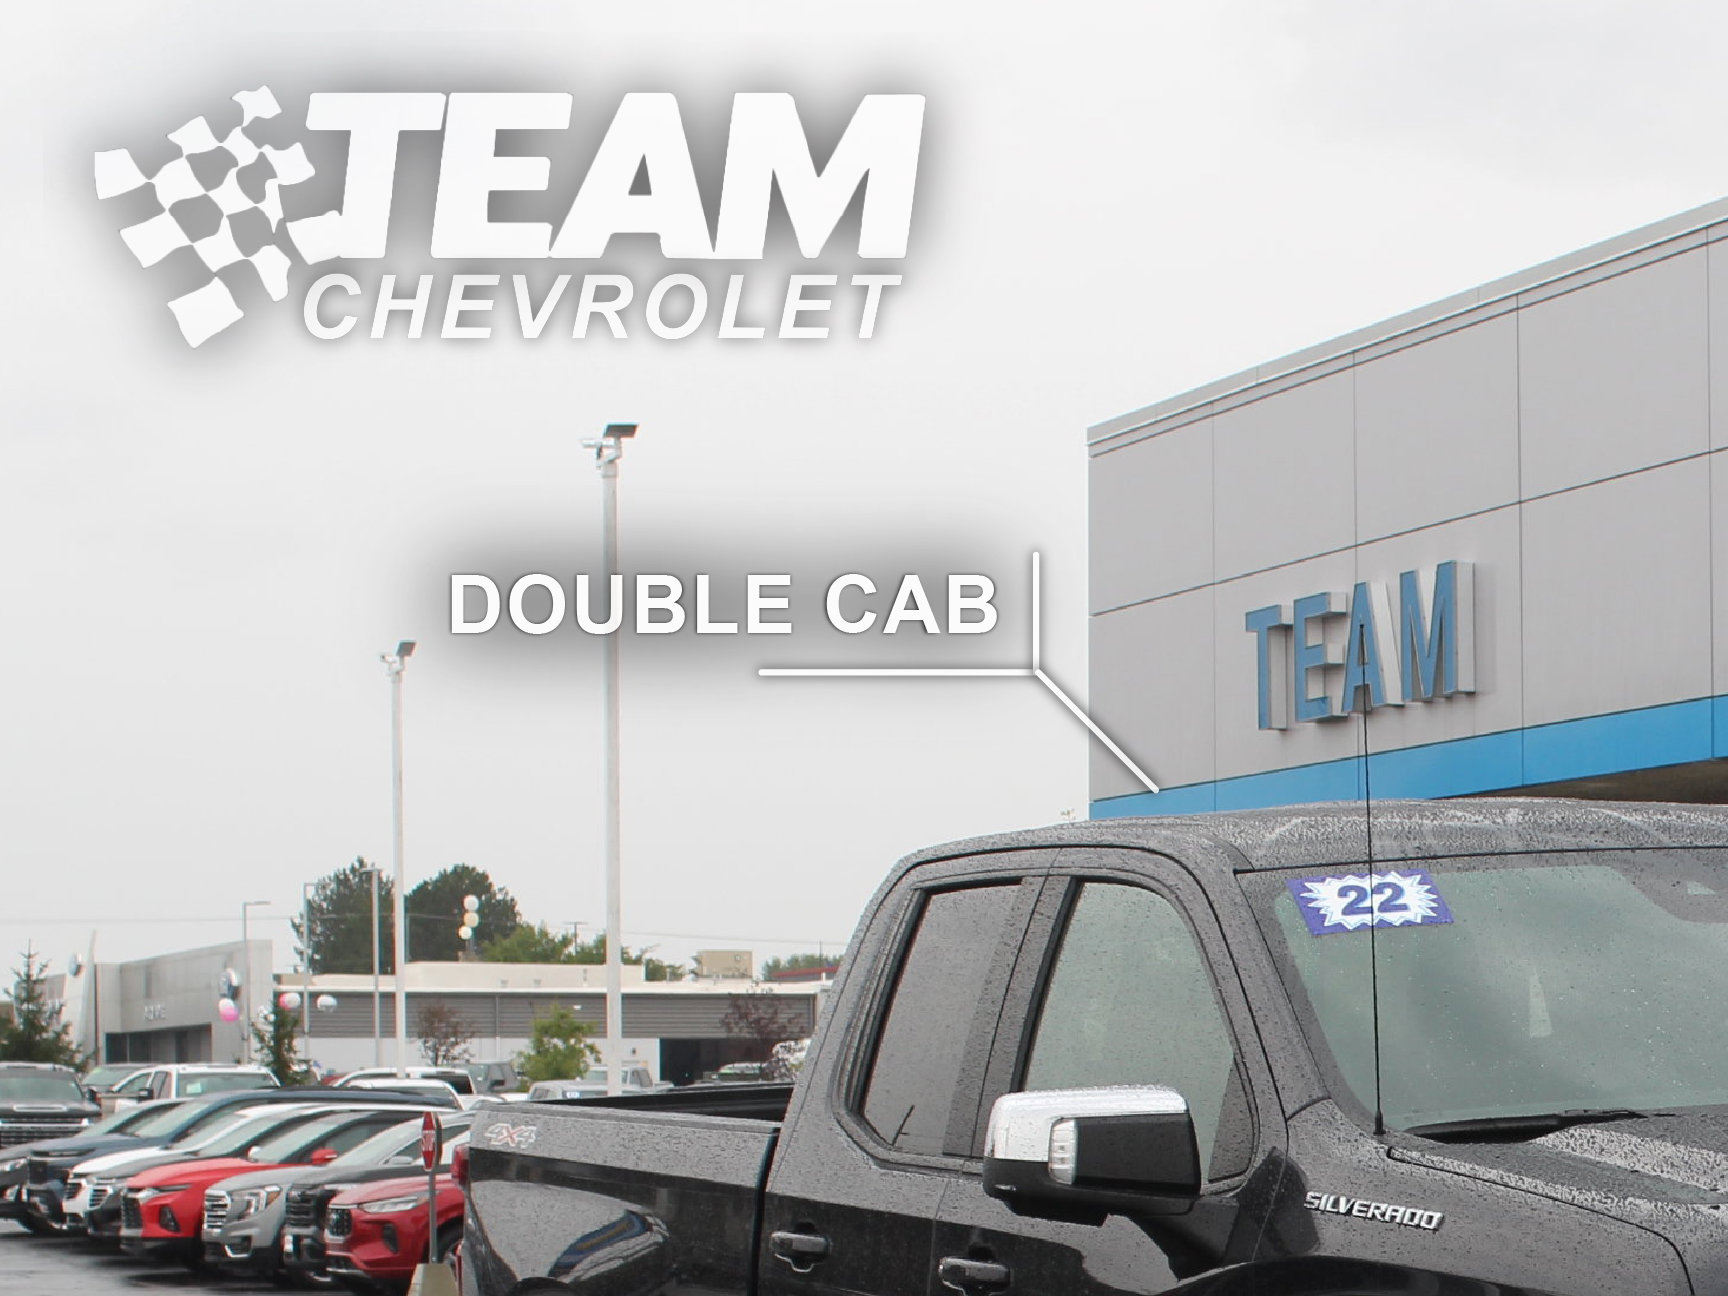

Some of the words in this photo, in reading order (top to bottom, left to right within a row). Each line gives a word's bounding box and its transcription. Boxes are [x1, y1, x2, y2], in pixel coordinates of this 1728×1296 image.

[1245, 560, 1476, 730] TEAM
[1337, 882, 1410, 916] 22
[1304, 1191, 1444, 1230] SILVERADO
